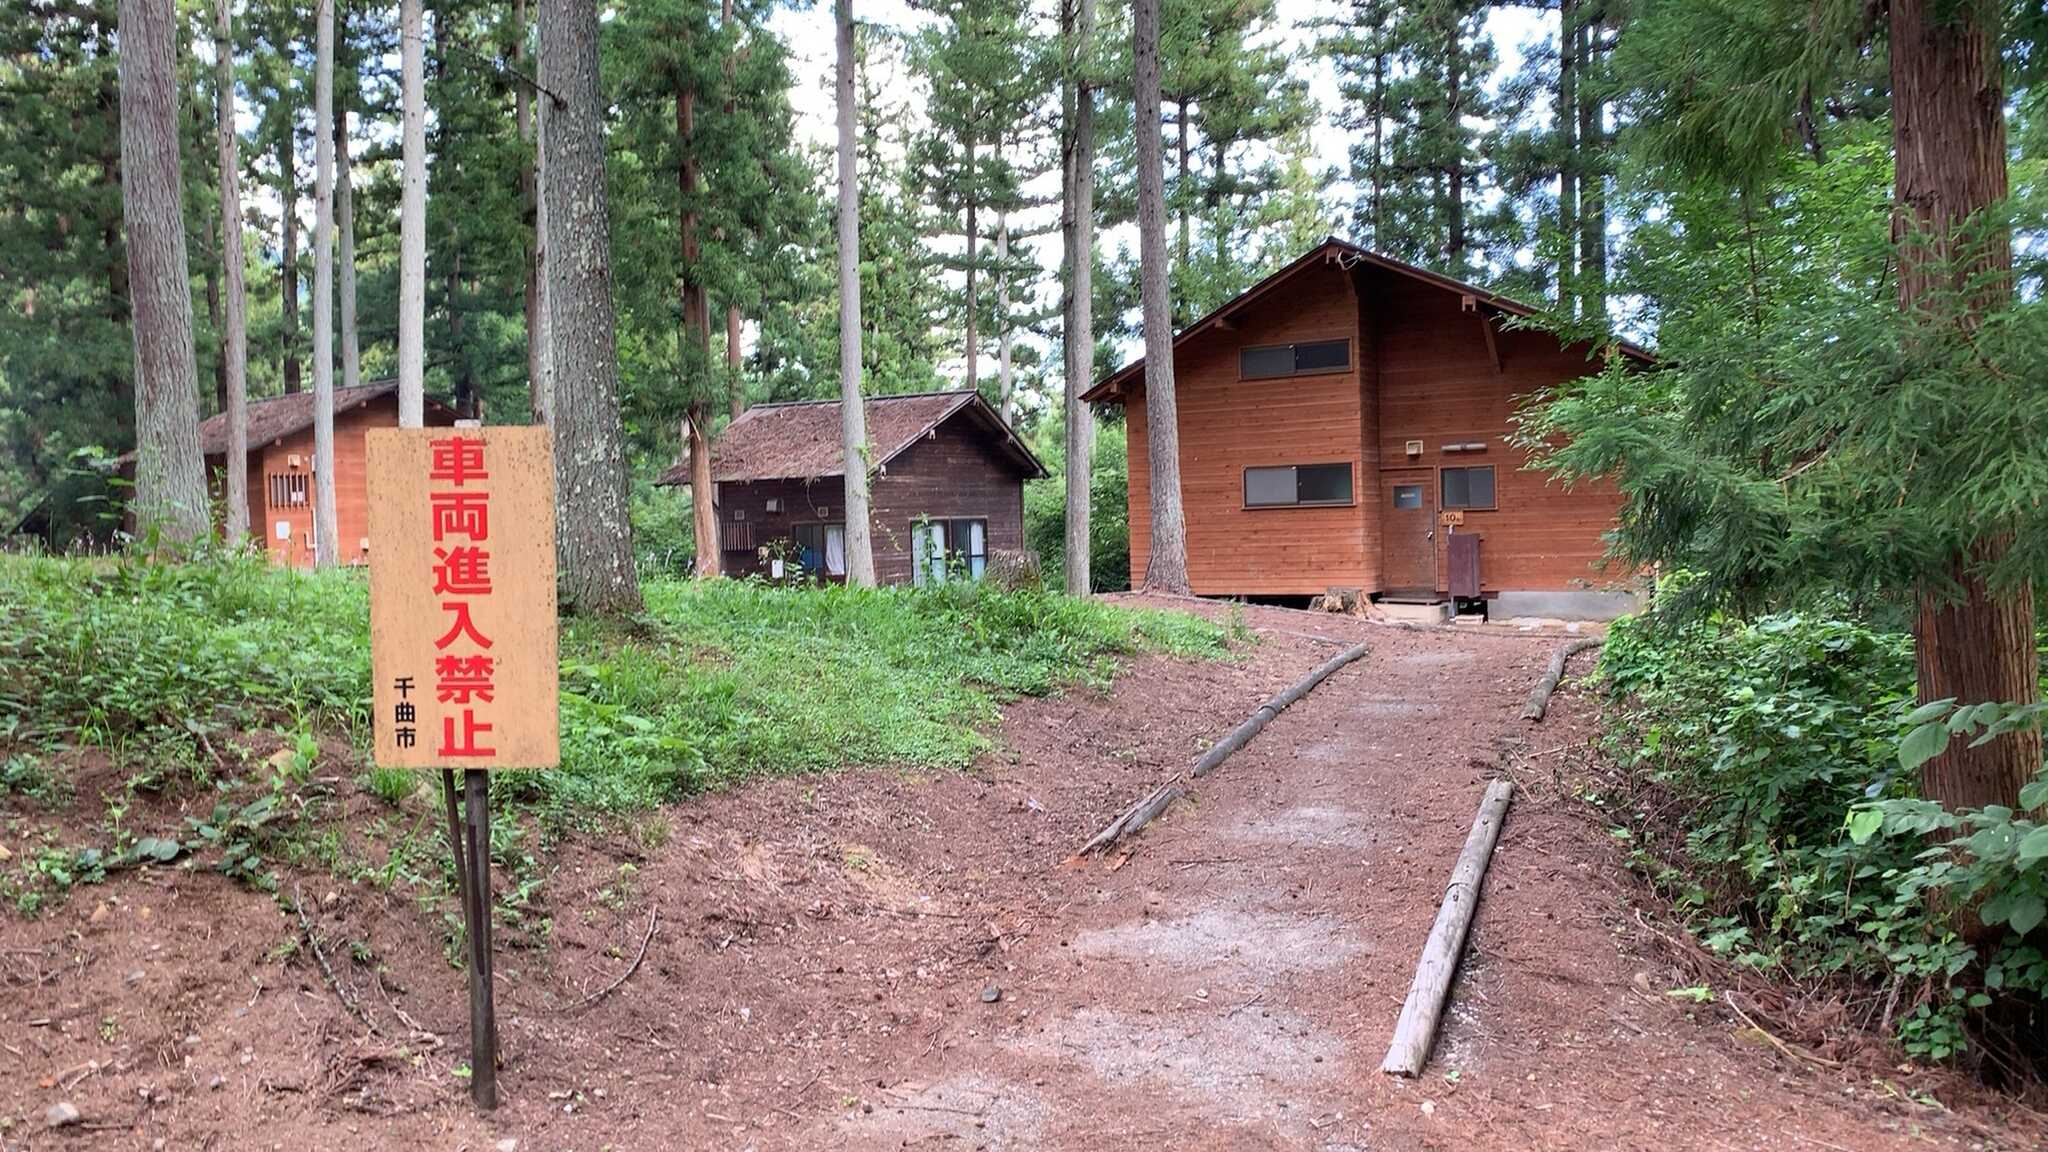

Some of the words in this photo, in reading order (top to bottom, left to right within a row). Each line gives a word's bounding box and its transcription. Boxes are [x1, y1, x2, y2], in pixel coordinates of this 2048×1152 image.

[429, 437, 496, 757] 車両進入禁止
[394, 677, 416, 749] 千曲市
